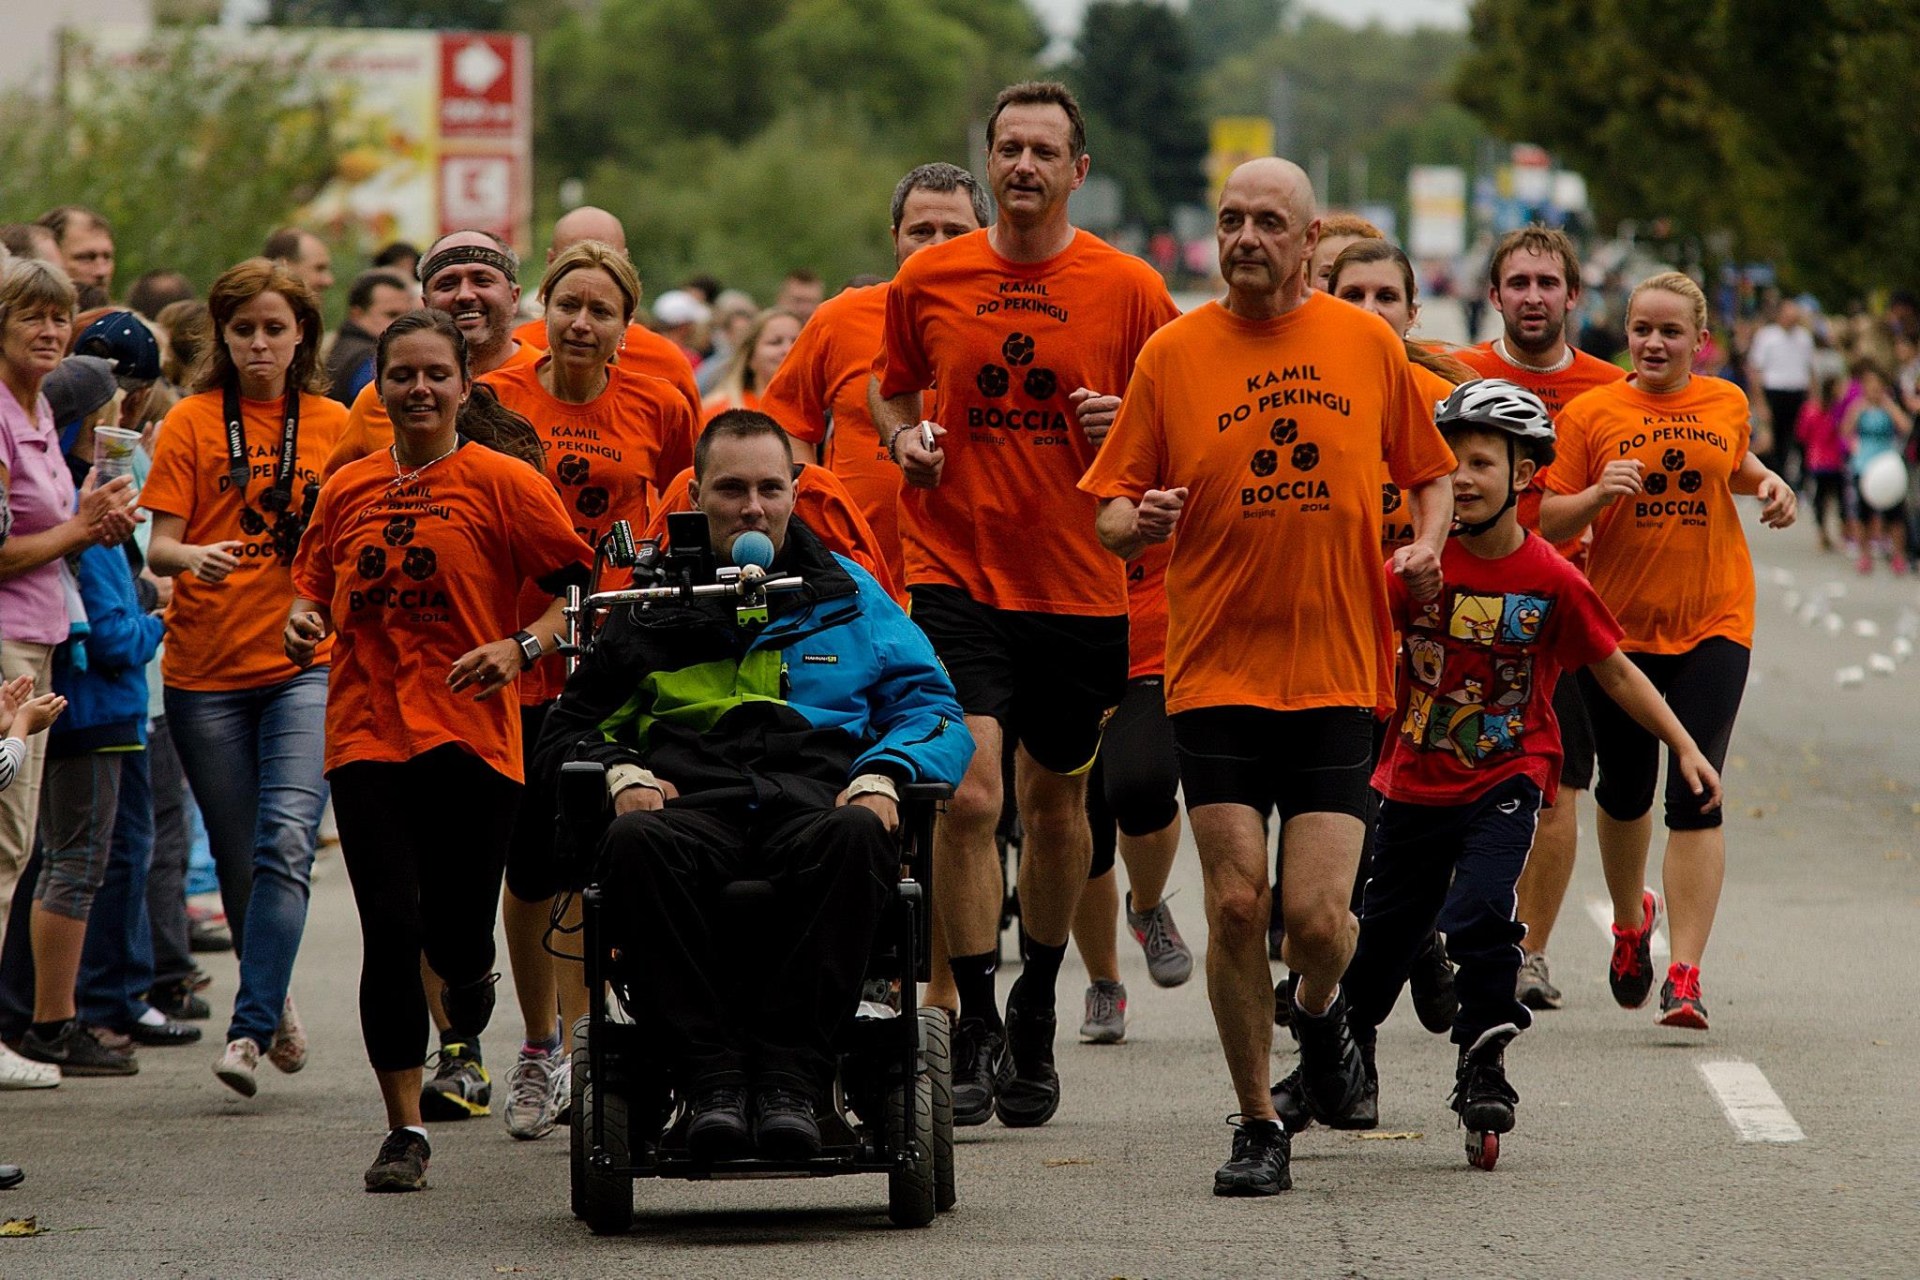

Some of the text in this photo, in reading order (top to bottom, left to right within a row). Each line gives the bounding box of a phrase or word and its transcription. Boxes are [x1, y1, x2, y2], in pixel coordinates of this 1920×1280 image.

[999, 282, 1049, 296] KAMIL
[976, 297, 1069, 323] DO PEKINGU
[1246, 364, 1321, 393] KAMIL
[968, 407, 1069, 432] BOCCIA
[1217, 388, 1350, 433] DO PEKINGU
[229, 420, 243, 458] Canon
[551, 426, 600, 441] KAMIL
[970, 432, 1069, 446] Beijing 2014
[1619, 427, 1728, 456] DO PEKINGU
[280, 440, 293, 480] DIGITAL
[557, 440, 622, 462] PEKINGU
[1241, 480, 1331, 506] BOCCIA
[1243, 502, 1330, 521] Beijing 2014
[1635, 500, 1707, 518] BOCCIA
[350, 587, 450, 612] BOCCIA
